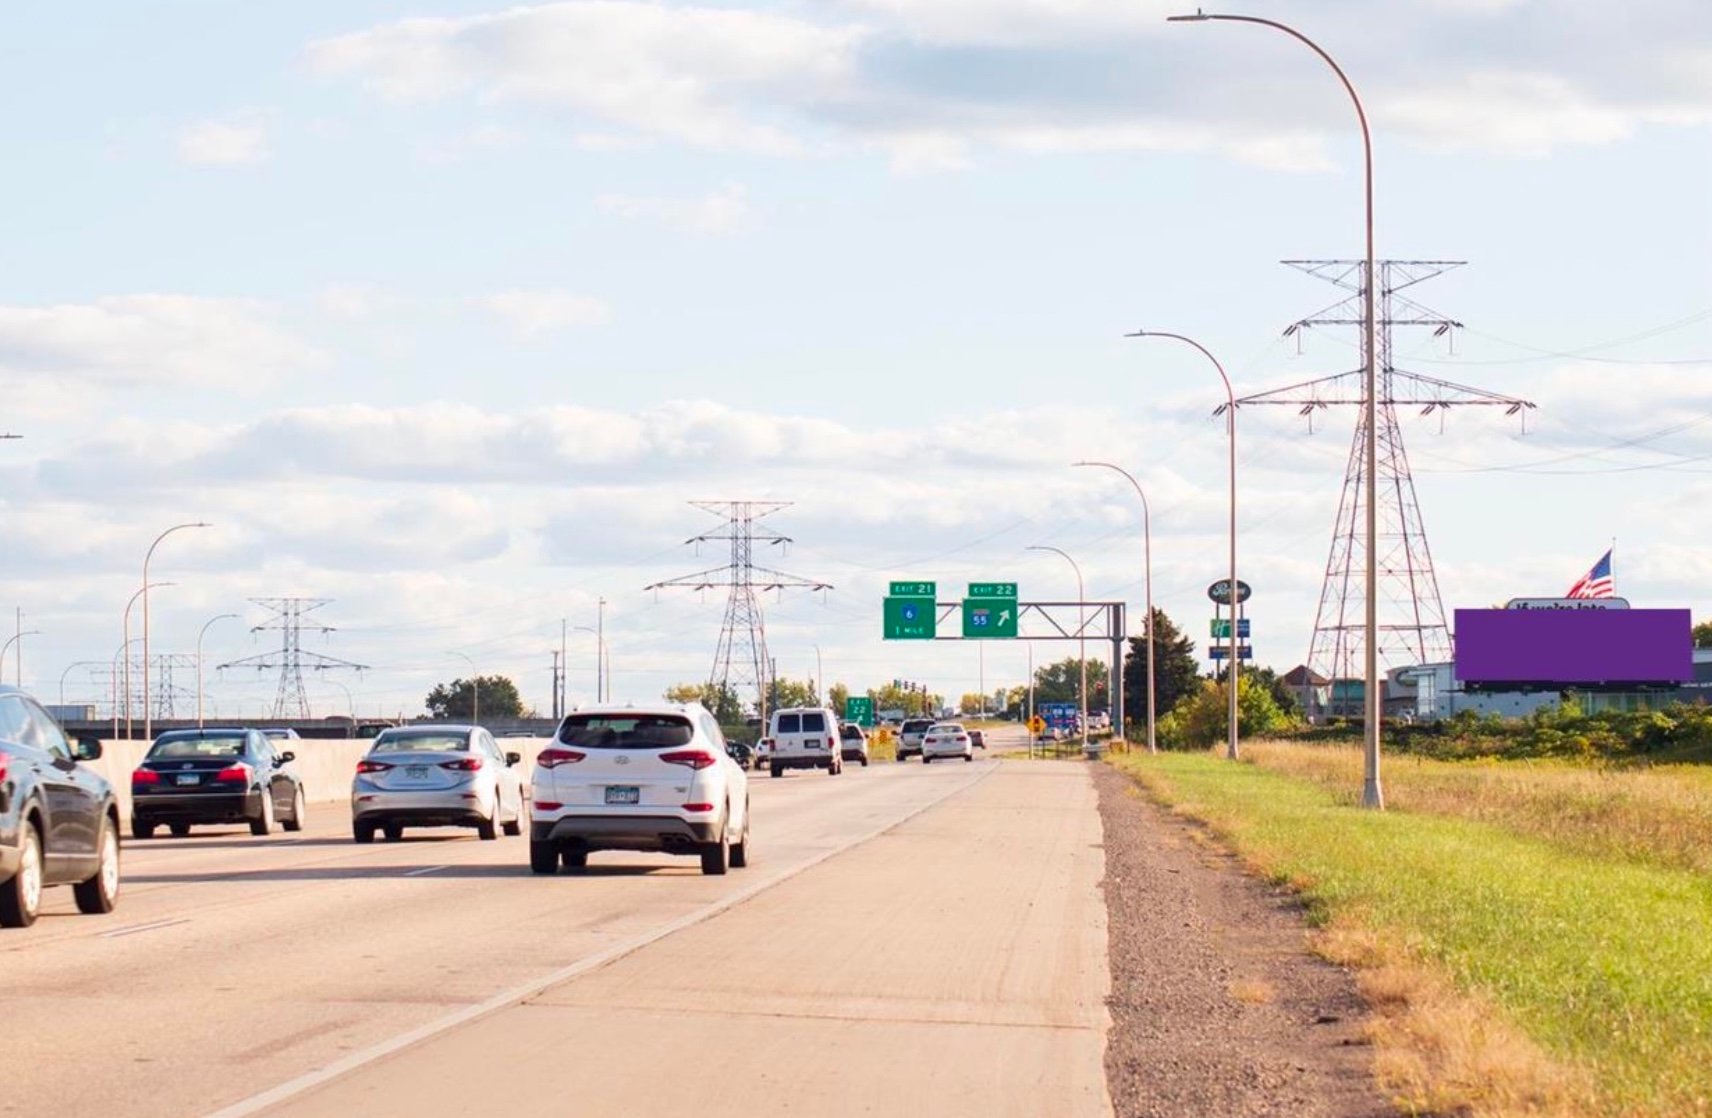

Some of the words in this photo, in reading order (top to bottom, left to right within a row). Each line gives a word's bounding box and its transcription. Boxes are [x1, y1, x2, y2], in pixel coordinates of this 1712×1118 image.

[918, 584, 931, 593] 21
[996, 585, 1012, 595] 22
[906, 610, 913, 619] 6
[973, 615, 987, 625] 55
